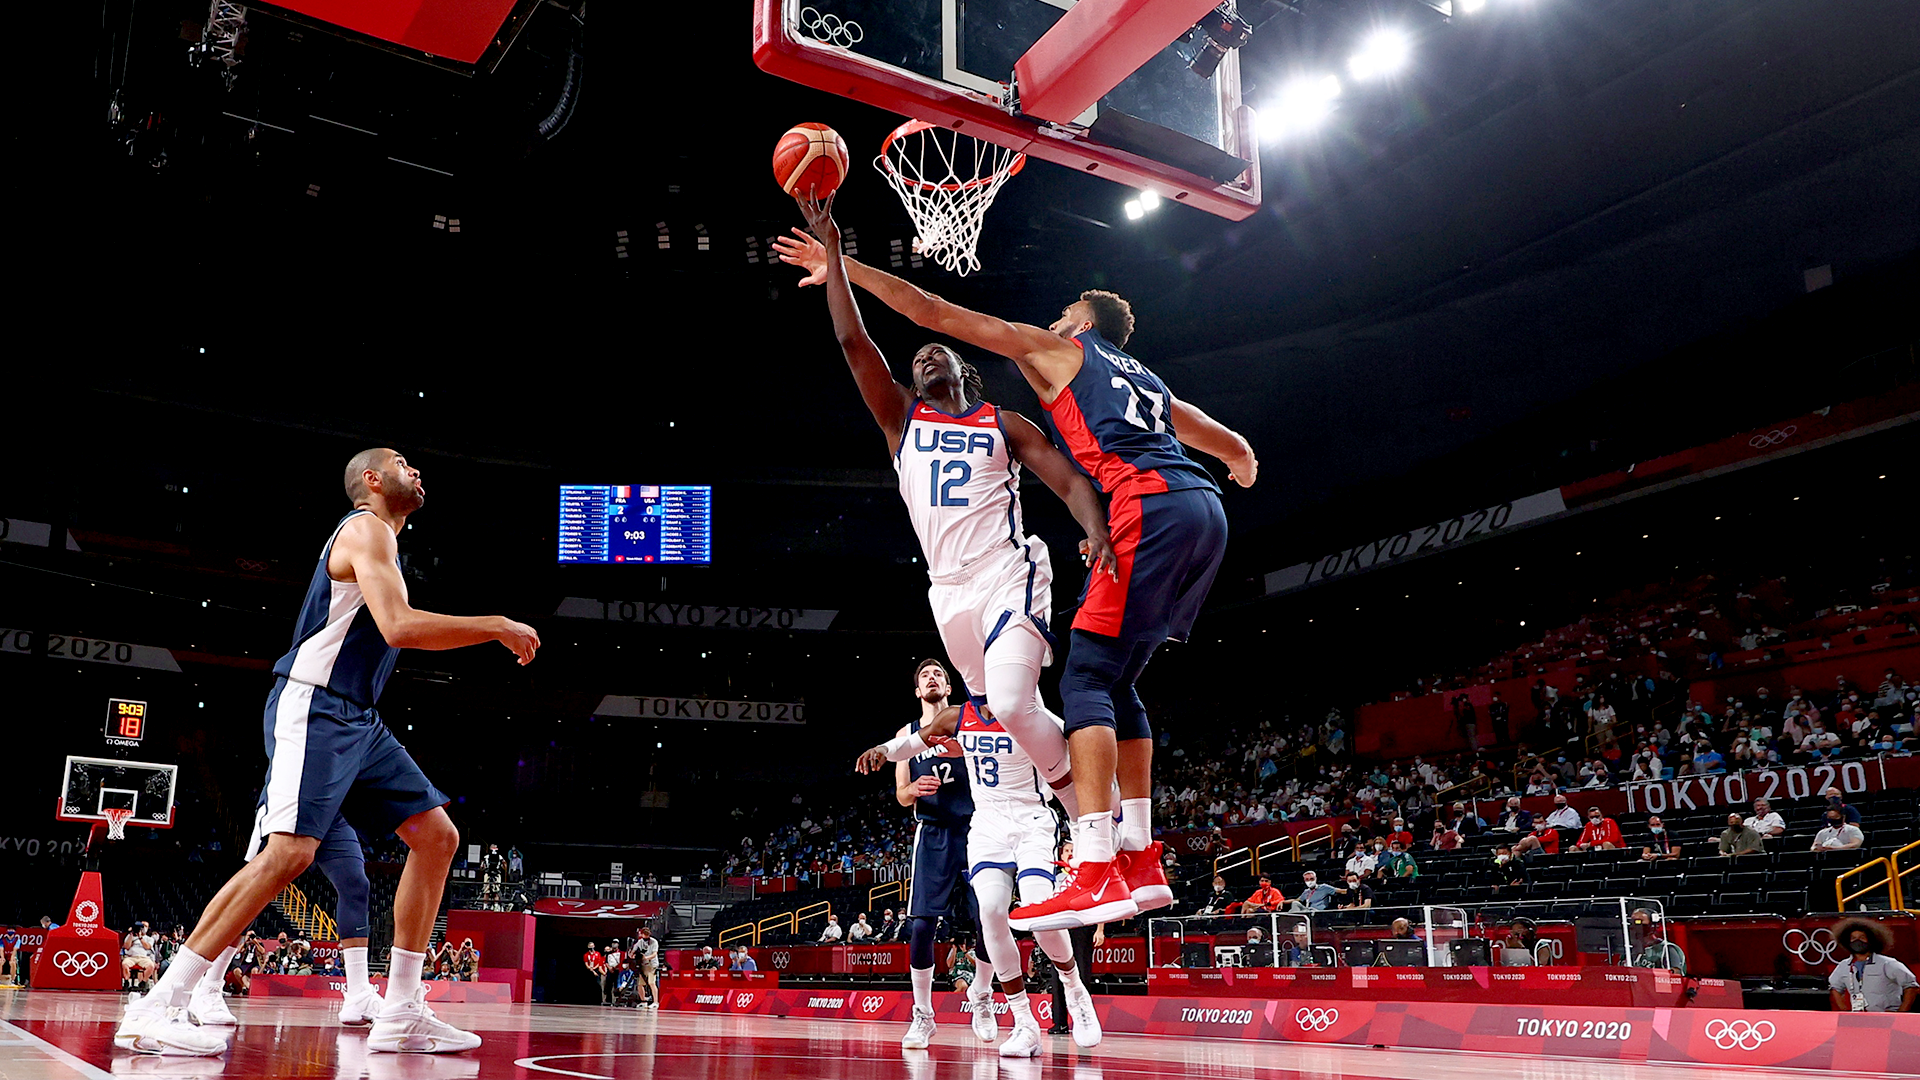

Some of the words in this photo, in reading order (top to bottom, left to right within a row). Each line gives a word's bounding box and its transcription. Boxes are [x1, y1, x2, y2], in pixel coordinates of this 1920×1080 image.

[1111, 376, 1166, 434] 27
[915, 428, 995, 457] USA
[930, 460, 972, 507] 12
[617, 505, 624, 515] 2
[646, 505, 653, 515] 0
[624, 530, 646, 540] 9:03
[1304, 532, 1413, 583] TOKYO
[1420, 502, 1513, 552] 2020
[601, 602, 705, 625] TOKYO
[714, 606, 794, 629] 2020
[49, 635, 132, 663] 2020
[118, 703, 144, 716] 9:03
[636, 697, 729, 719] TOKYO
[738, 702, 806, 722] 2020
[119, 717, 141, 737] 18
[113, 739, 139, 747] OMEGA
[963, 735, 1013, 754] USA
[932, 762, 955, 784] 12
[973, 756, 999, 788] 13
[1619, 774, 1748, 814] TOKYO
[1758, 761, 1867, 801] 2020
[872, 863, 911, 883] TOKYO
[847, 953, 872, 965] TOKYO
[872, 952, 892, 965] 2020
[1106, 947, 1135, 963] 2020
[1547, 973, 1565, 981] TOKYO
[1566, 973, 1581, 981] 2020
[1604, 973, 1624, 982] TOKYO
[695, 994, 711, 1004] TOKYO
[711, 995, 724, 1004] 2020
[808, 997, 827, 1008] TOKYO
[826, 998, 844, 1008] 2020
[1181, 1008, 1220, 1023] TOKYO
[1220, 1010, 1253, 1024] 2020
[1517, 1018, 1579, 1038] TOKYO
[1581, 1020, 1632, 1041] 2020
